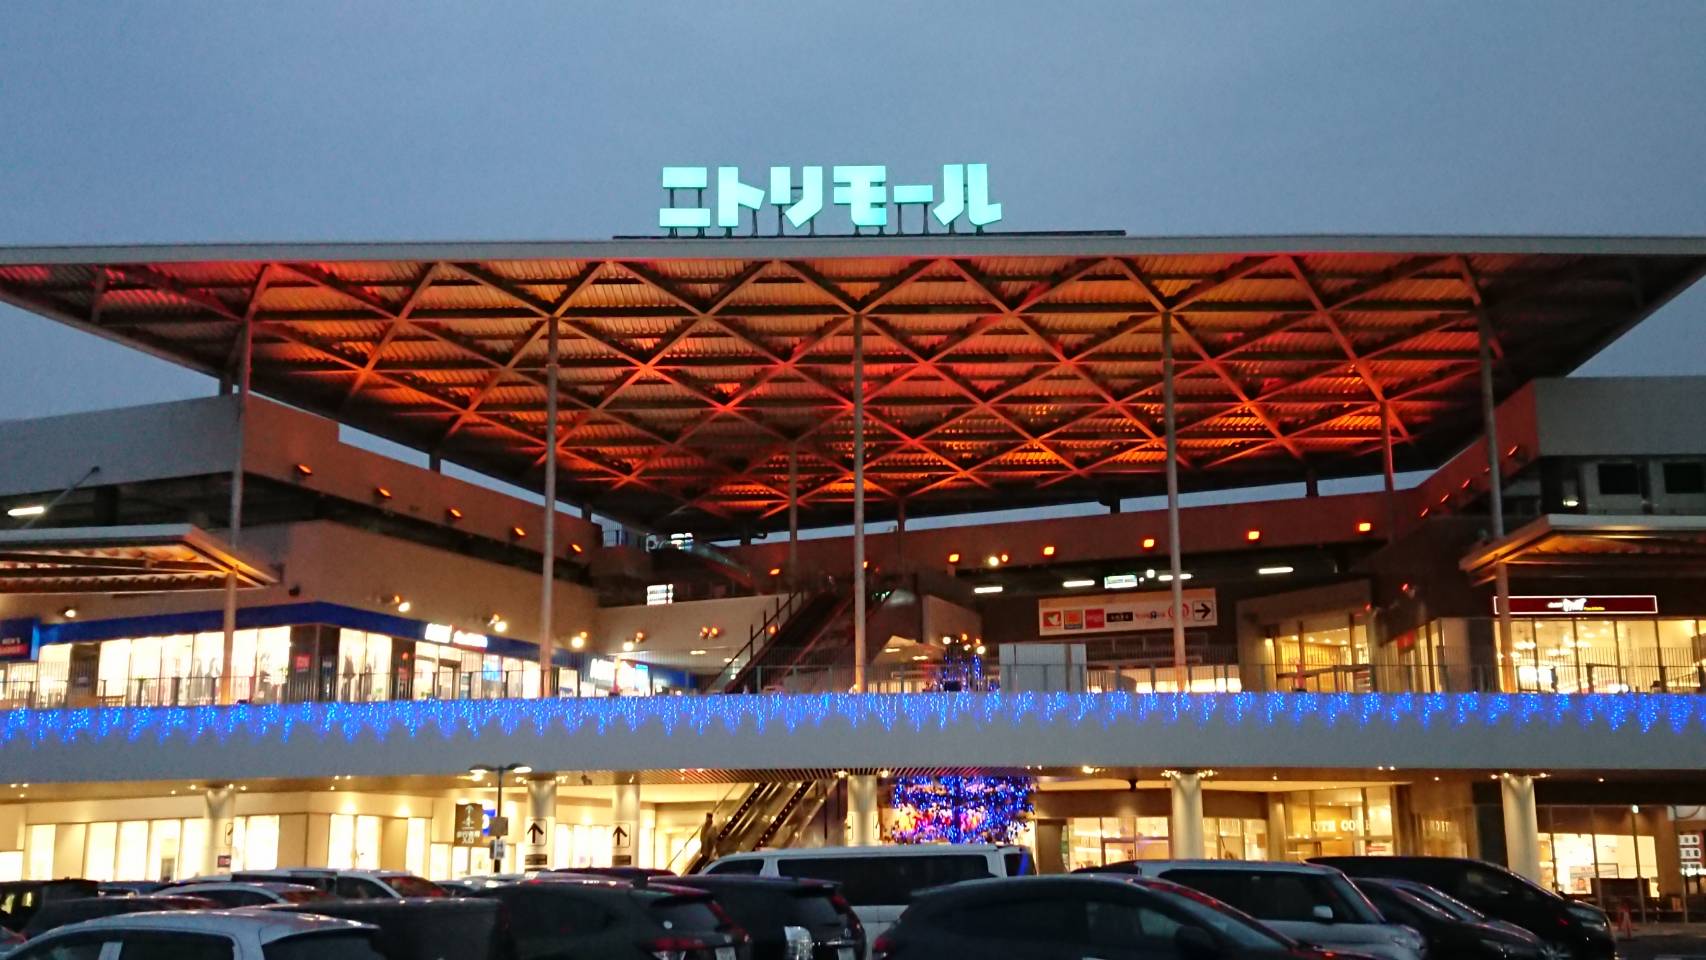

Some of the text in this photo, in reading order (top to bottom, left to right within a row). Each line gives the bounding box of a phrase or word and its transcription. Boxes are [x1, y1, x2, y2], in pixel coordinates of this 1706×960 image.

[659, 163, 1002, 229] ニトリモール
